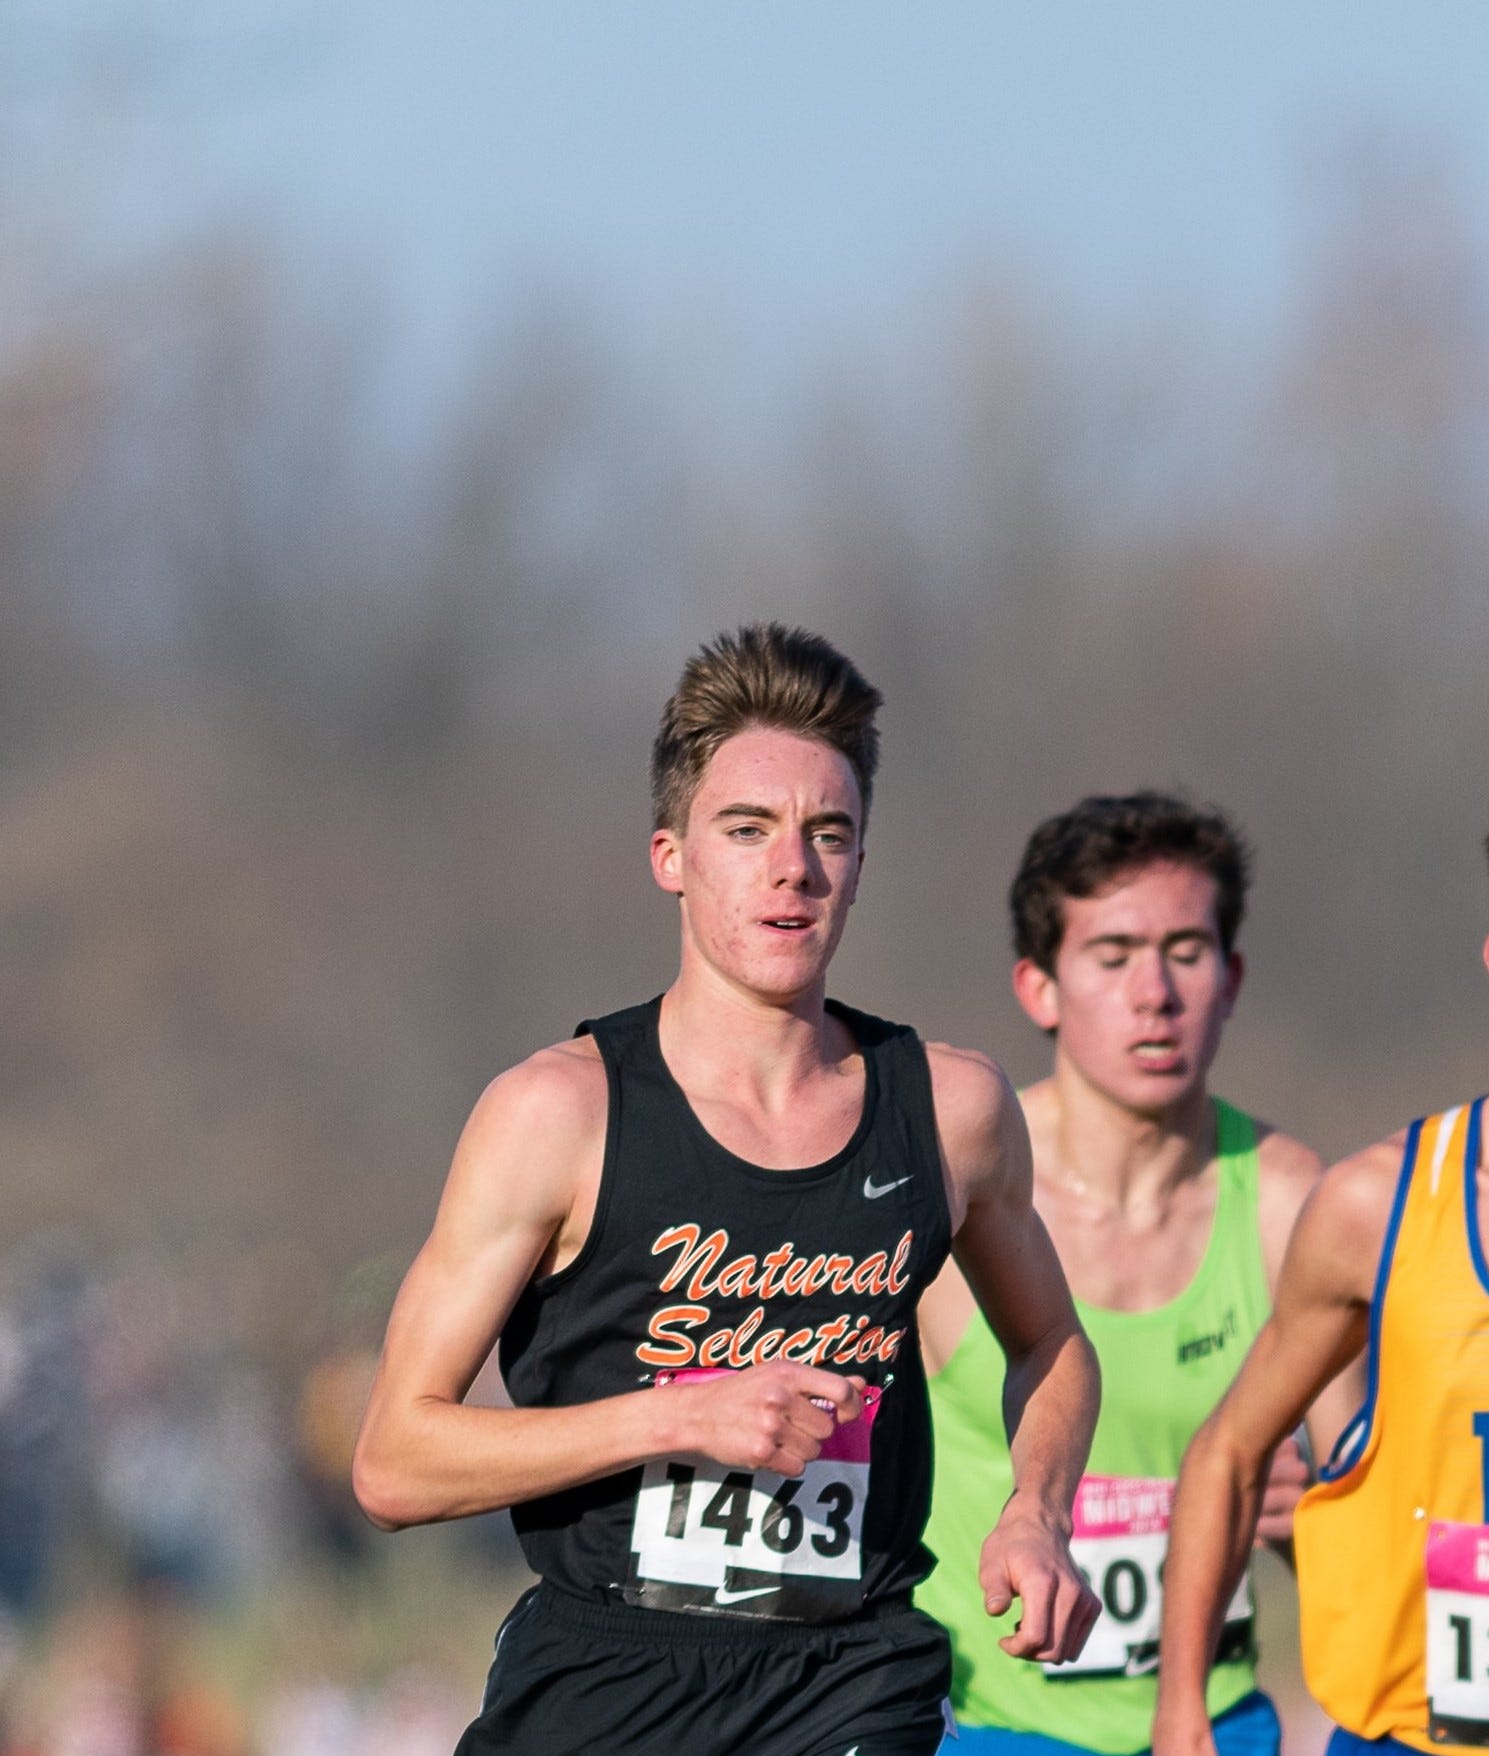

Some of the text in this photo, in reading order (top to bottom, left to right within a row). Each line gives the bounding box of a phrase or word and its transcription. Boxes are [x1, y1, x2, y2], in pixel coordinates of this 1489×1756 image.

[652, 1223, 913, 1300] Natural
[636, 1305, 906, 1367] Selection
[665, 1462, 853, 1558] 1463
